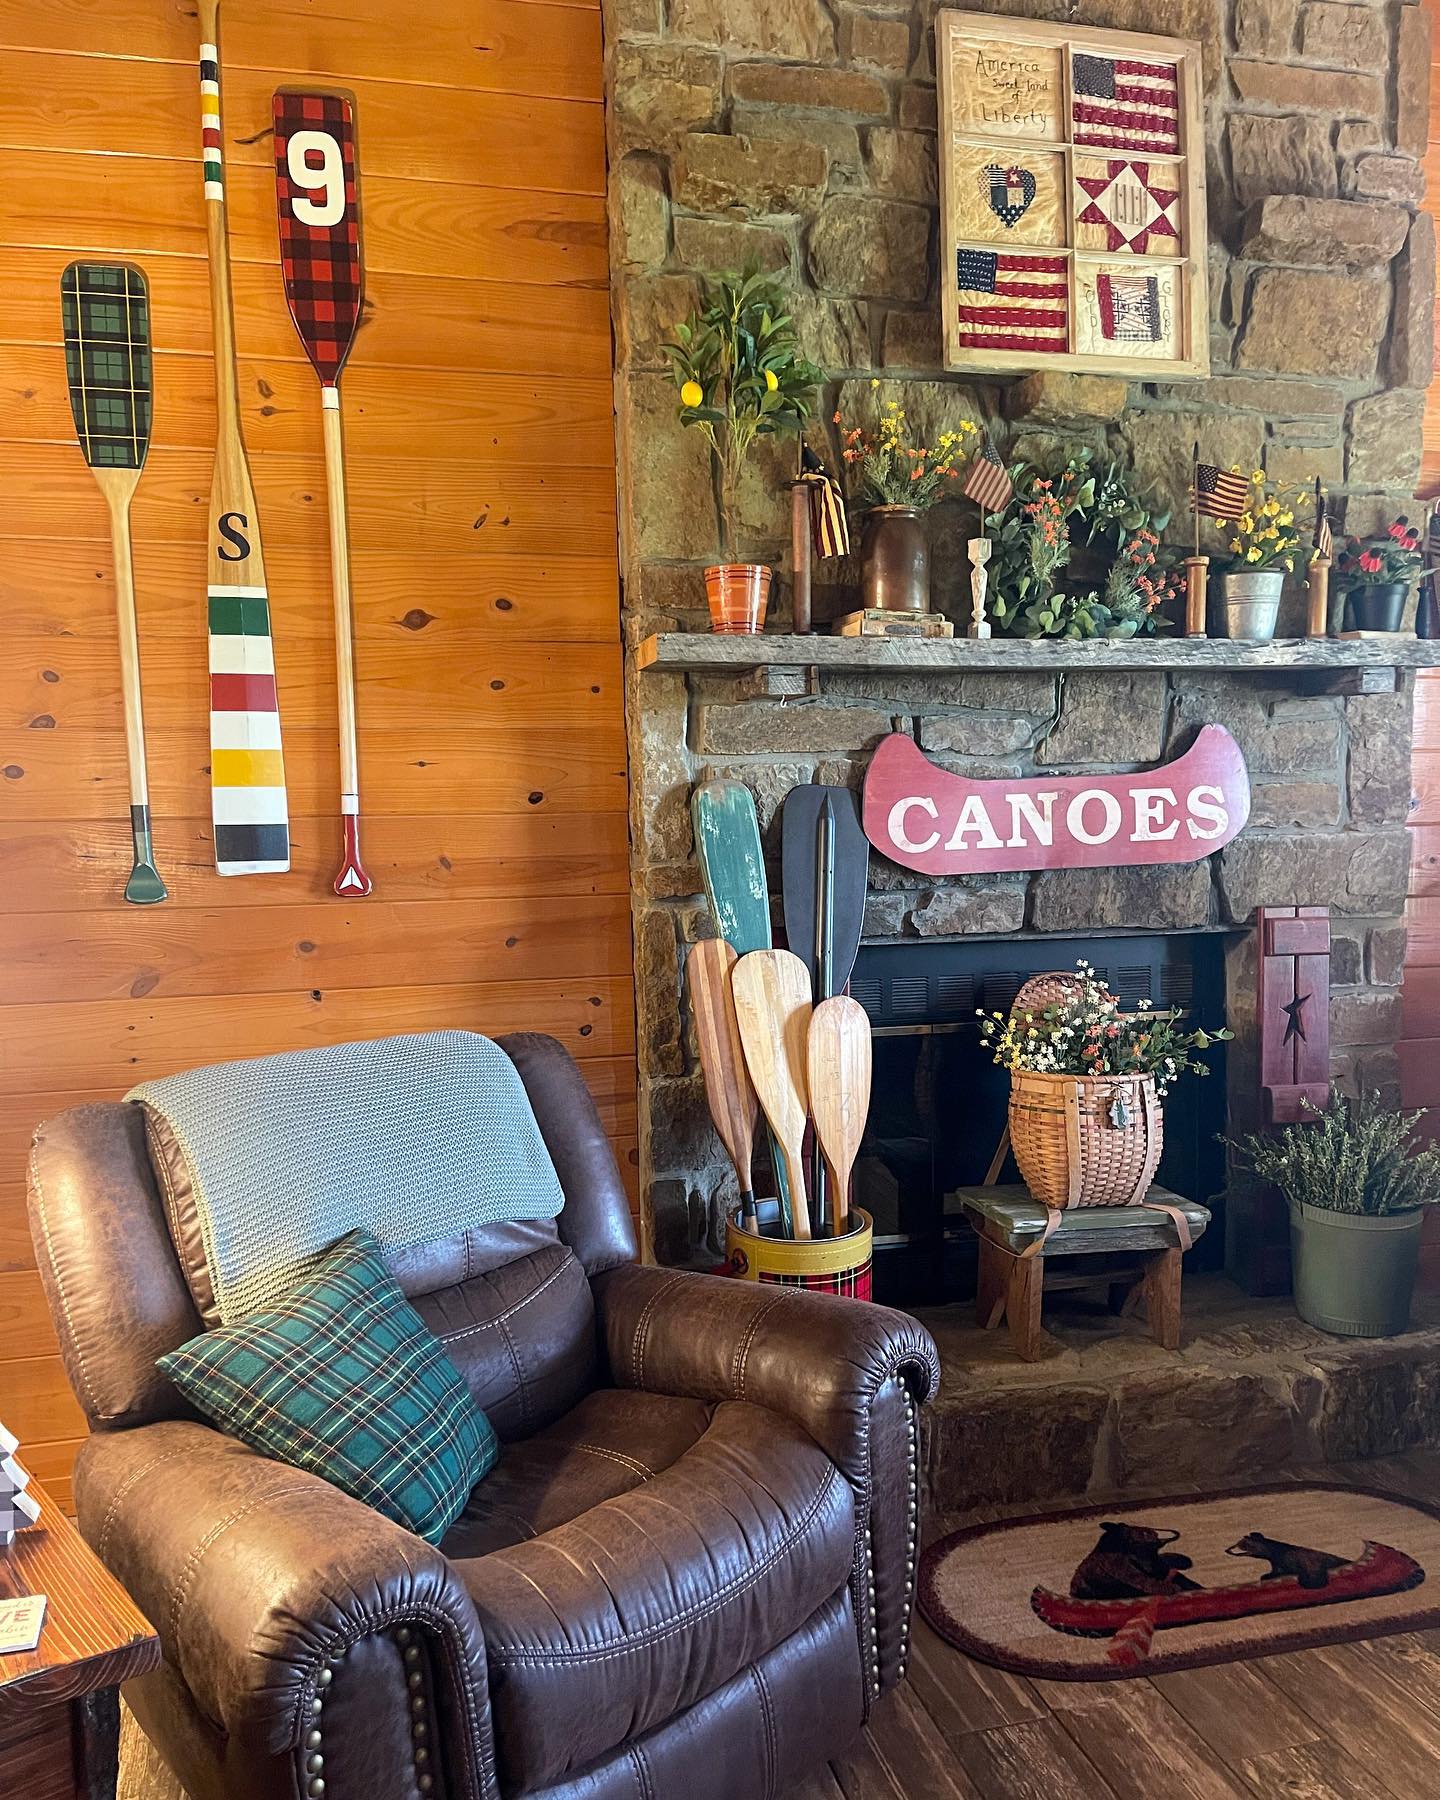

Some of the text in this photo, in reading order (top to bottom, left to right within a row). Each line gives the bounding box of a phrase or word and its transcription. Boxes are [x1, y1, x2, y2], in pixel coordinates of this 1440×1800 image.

[976, 51, 1040, 77] America
[1012, 90, 1022, 105] of
[1027, 80, 1048, 92] land
[981, 103, 1046, 133] Liberty
[287, 130, 346, 227] 9
[1160, 281, 1173, 342] GLORY
[217, 512, 251, 562] S
[887, 785, 1229, 854] CANOES
